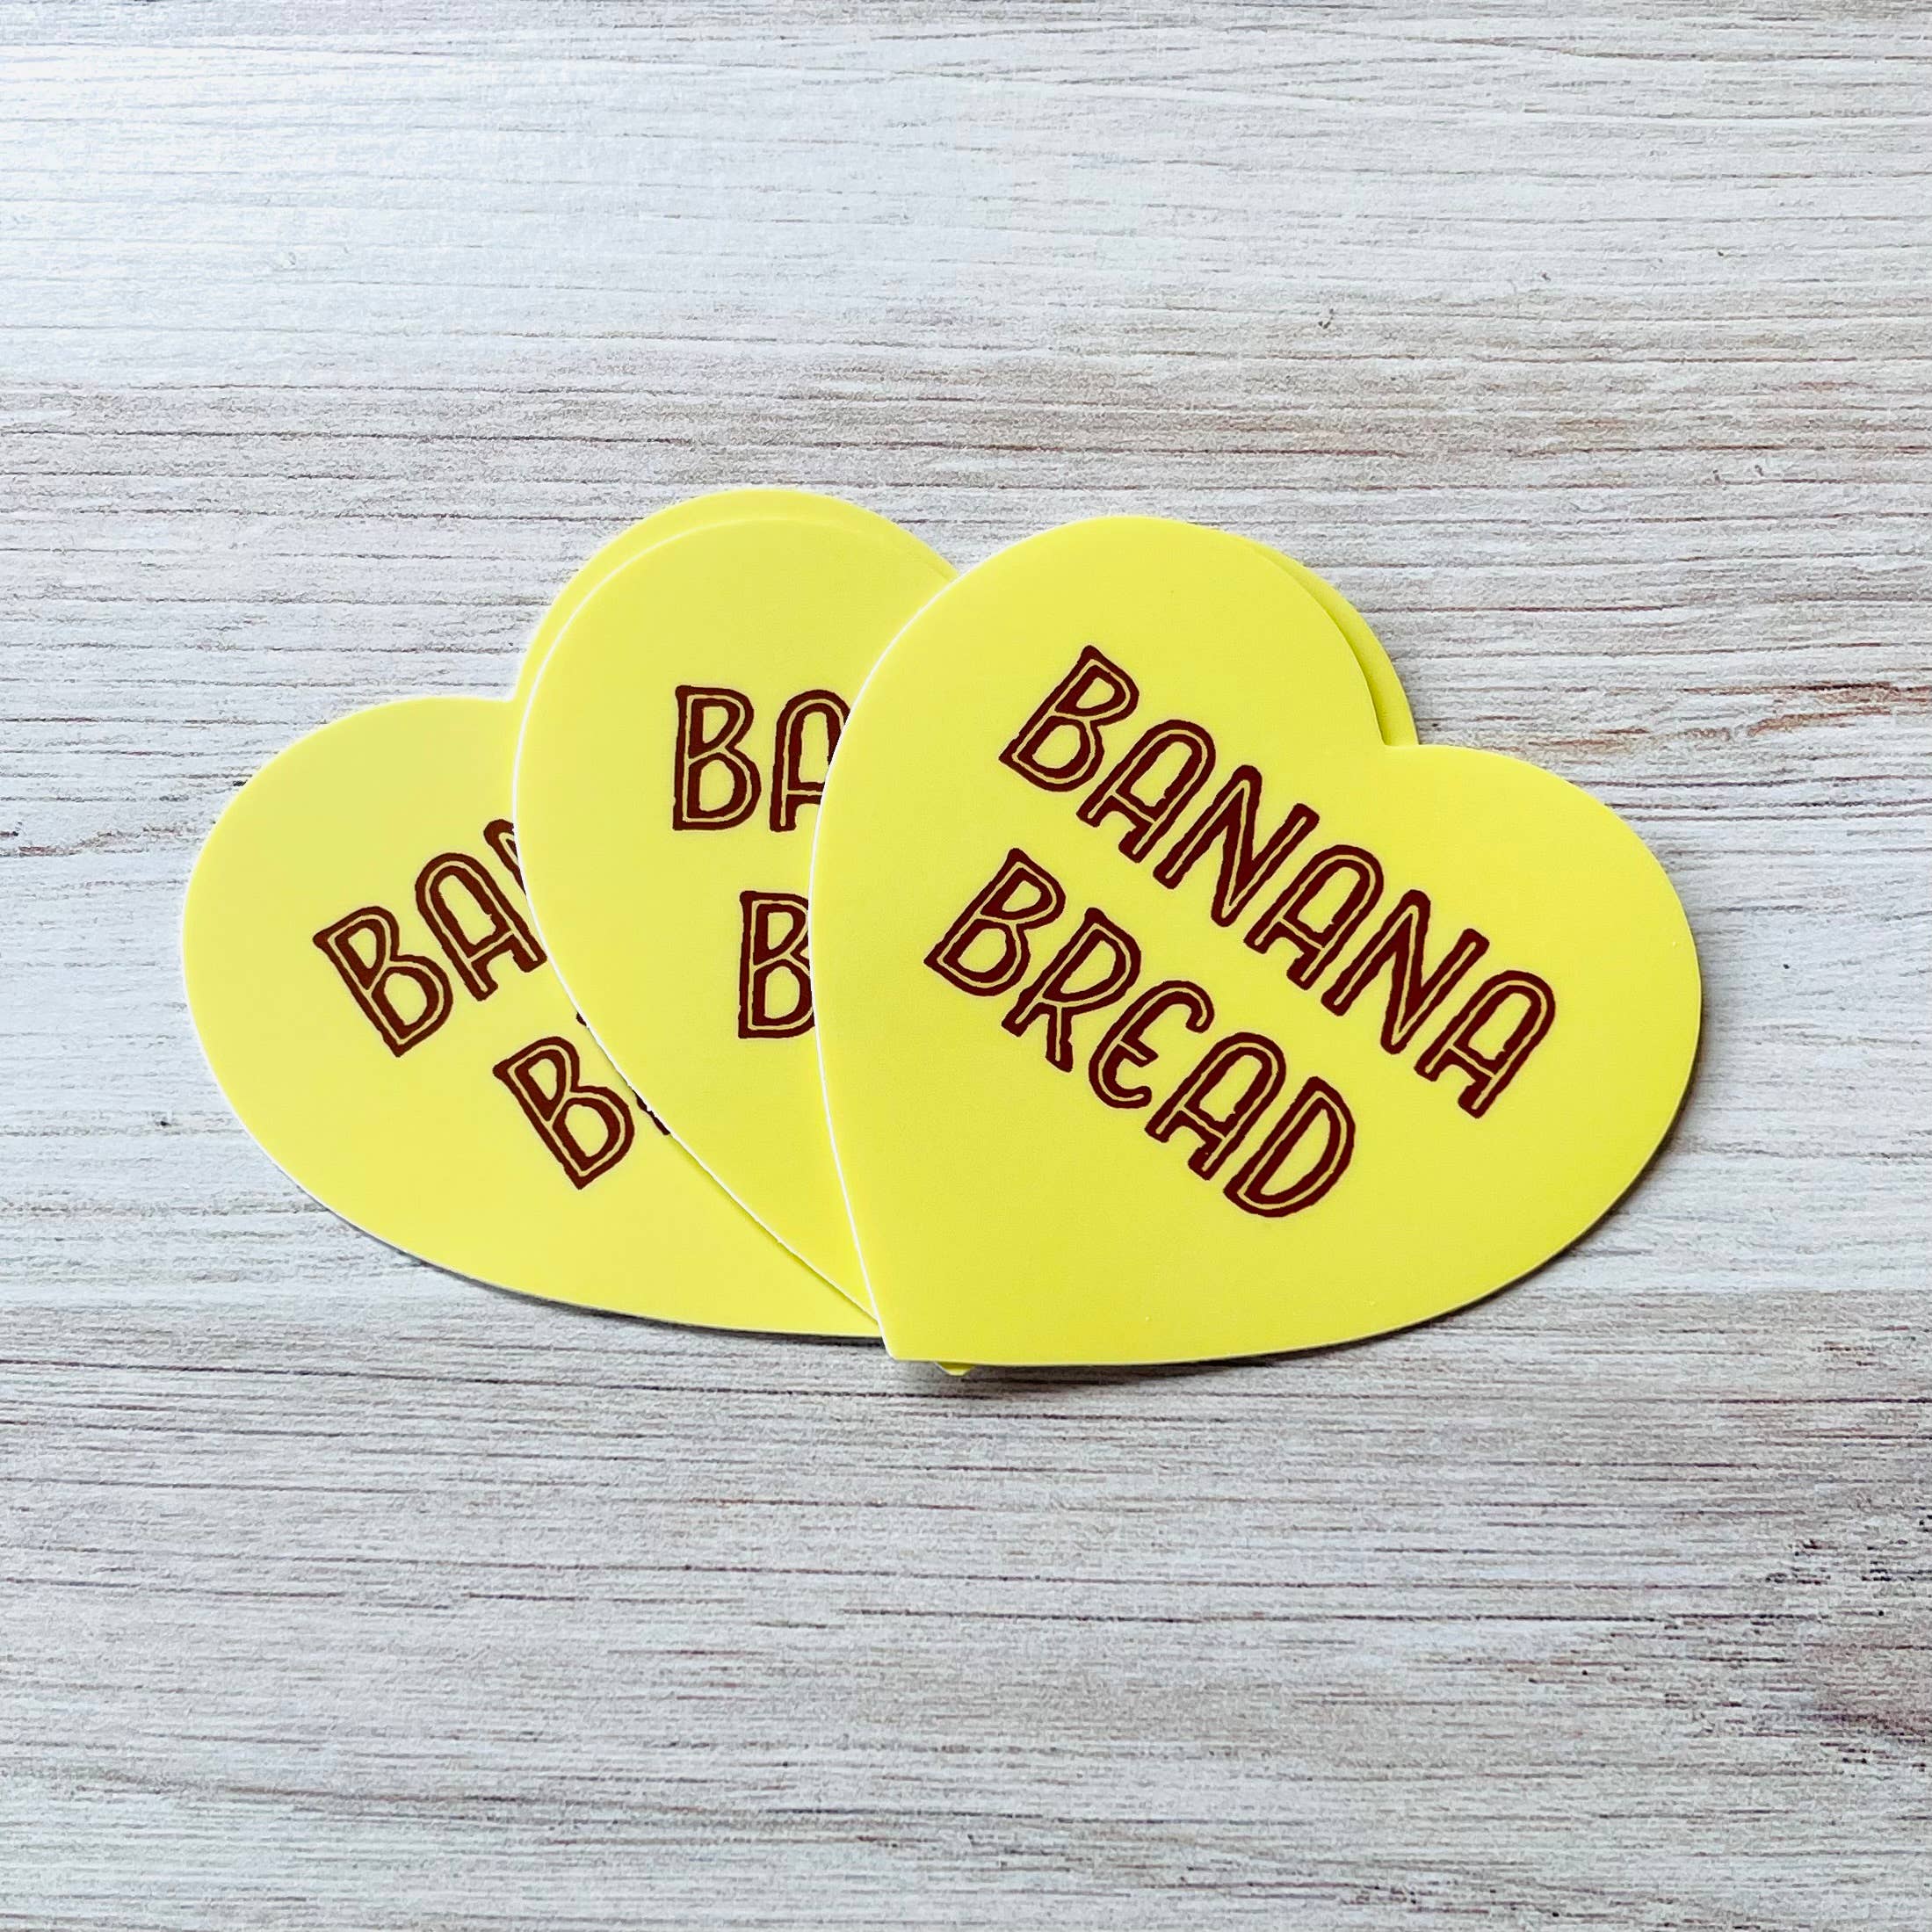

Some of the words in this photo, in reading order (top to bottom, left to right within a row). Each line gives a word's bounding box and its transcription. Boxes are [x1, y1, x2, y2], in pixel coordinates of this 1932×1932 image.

[313, 819, 547, 1057] BA
[923, 848, 1356, 1218] BREAD
[999, 645, 1555, 1118] BANANA
